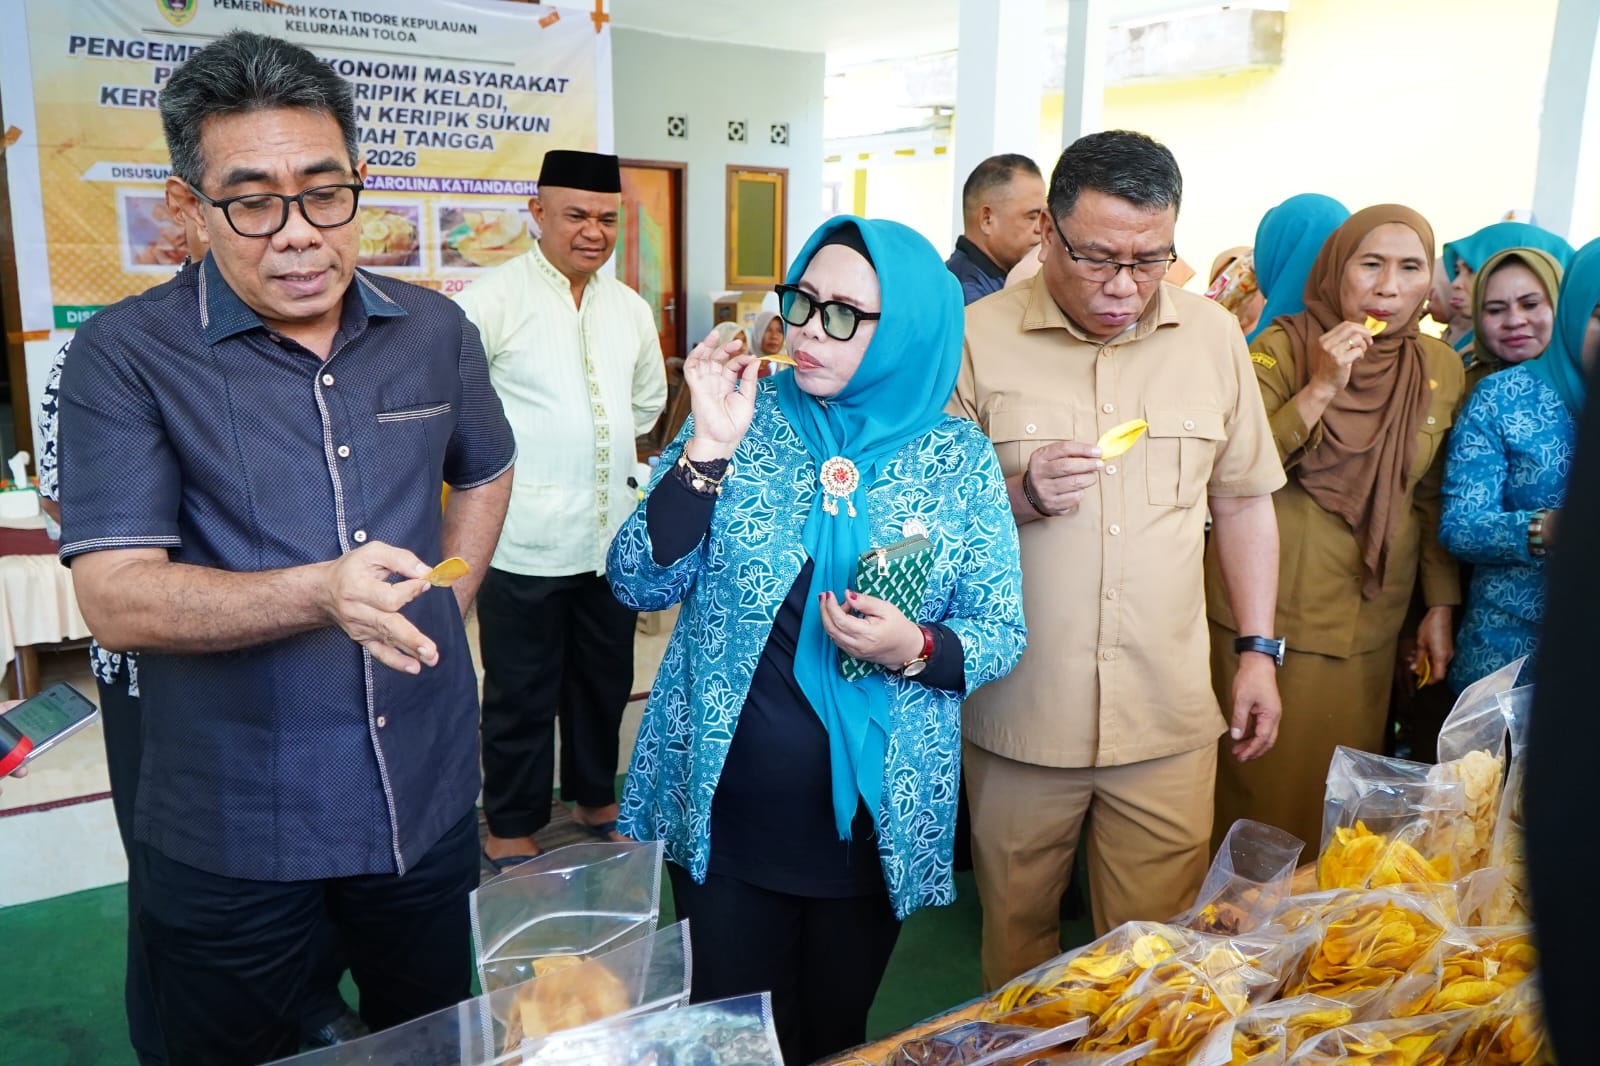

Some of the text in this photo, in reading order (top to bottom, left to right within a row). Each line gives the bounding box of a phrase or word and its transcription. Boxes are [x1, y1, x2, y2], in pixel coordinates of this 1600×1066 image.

[213, 0, 477, 34] PEMERINTAH KOTA TIDORE KEPULAUAN
[286, 20, 416, 42] KELURAHAN TOLOA
[423, 66, 569, 94] MASYARAKAT
[101, 86, 160, 108] KER
[378, 106, 469, 128] KERIPIK
[476, 113, 550, 132] SUKUN
[355, 83, 417, 104] RIPIK
[424, 88, 507, 113] KELADI,
[403, 130, 494, 150] TANGGA
[366, 149, 417, 167] 2026
[363, 176, 435, 191] CAROLINA
[66, 311, 97, 323] DIS
